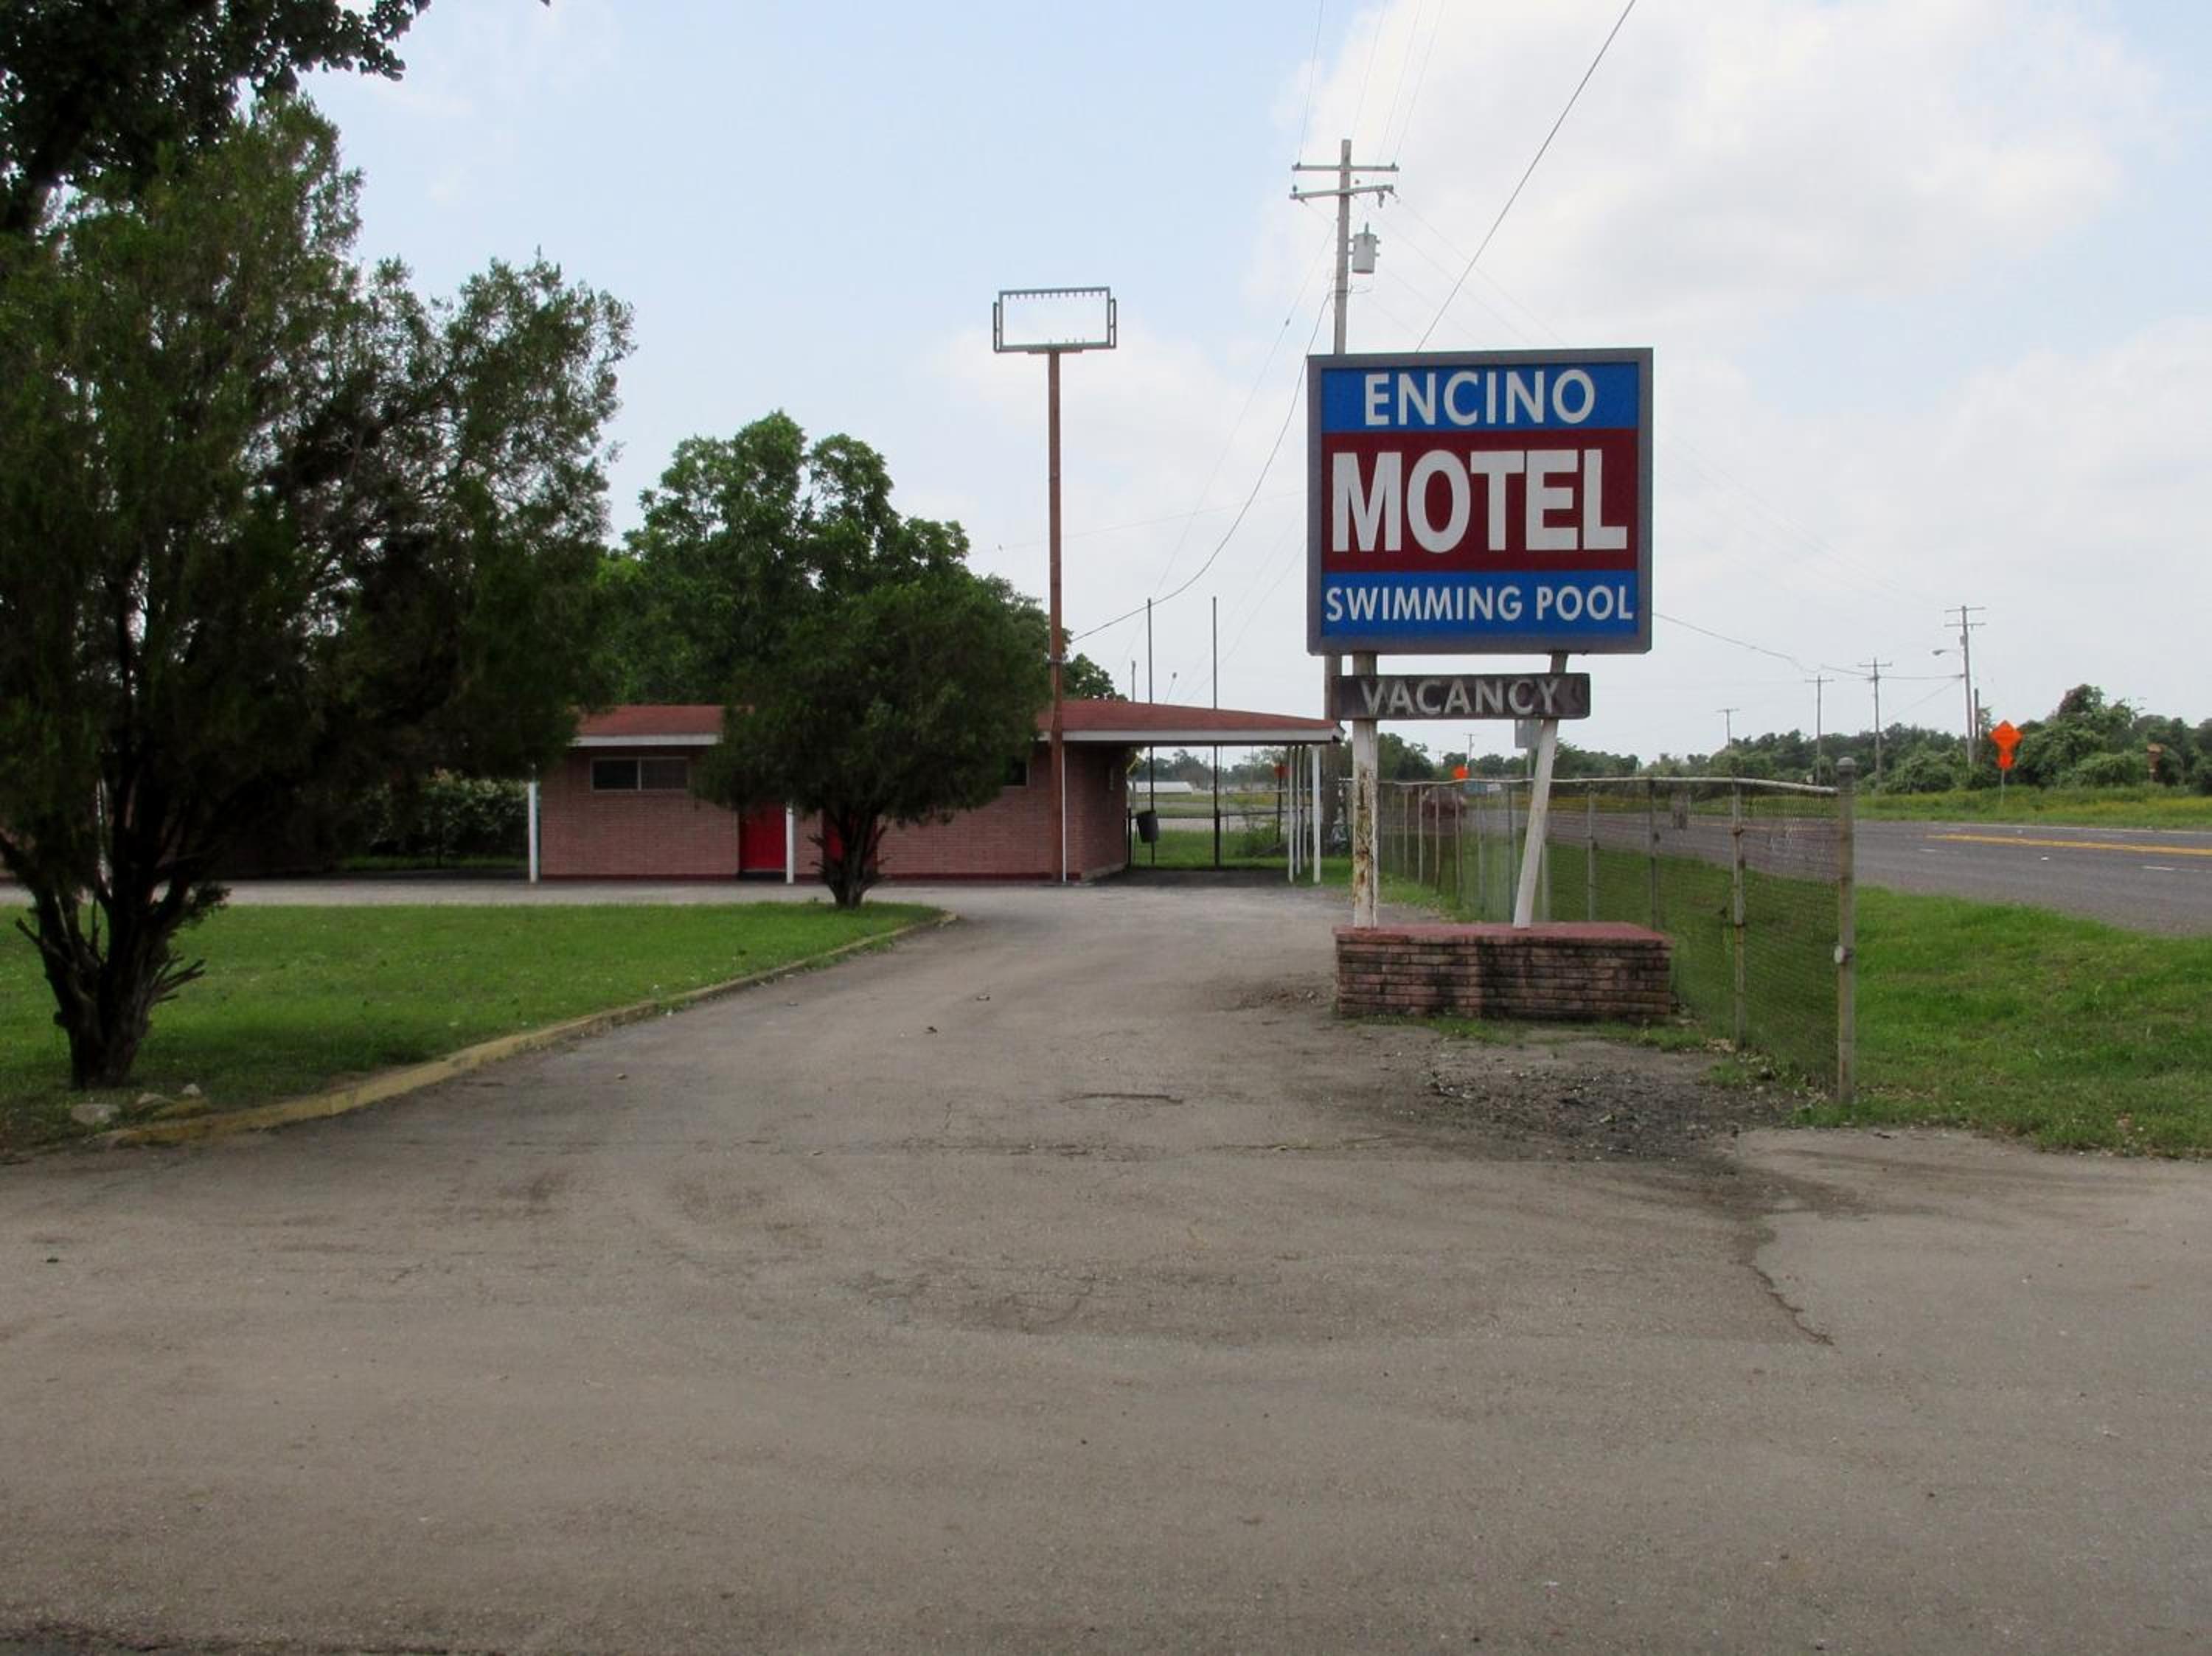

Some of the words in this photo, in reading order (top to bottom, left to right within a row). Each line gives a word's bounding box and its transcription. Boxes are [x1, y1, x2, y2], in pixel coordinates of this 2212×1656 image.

[1364, 369, 1596, 425] ENCINO
[1332, 449, 1627, 553] MOTEL
[1326, 586, 1523, 621] SWIMMING
[1537, 585, 1633, 620] POOL
[1360, 678, 1561, 715] VACANCY
